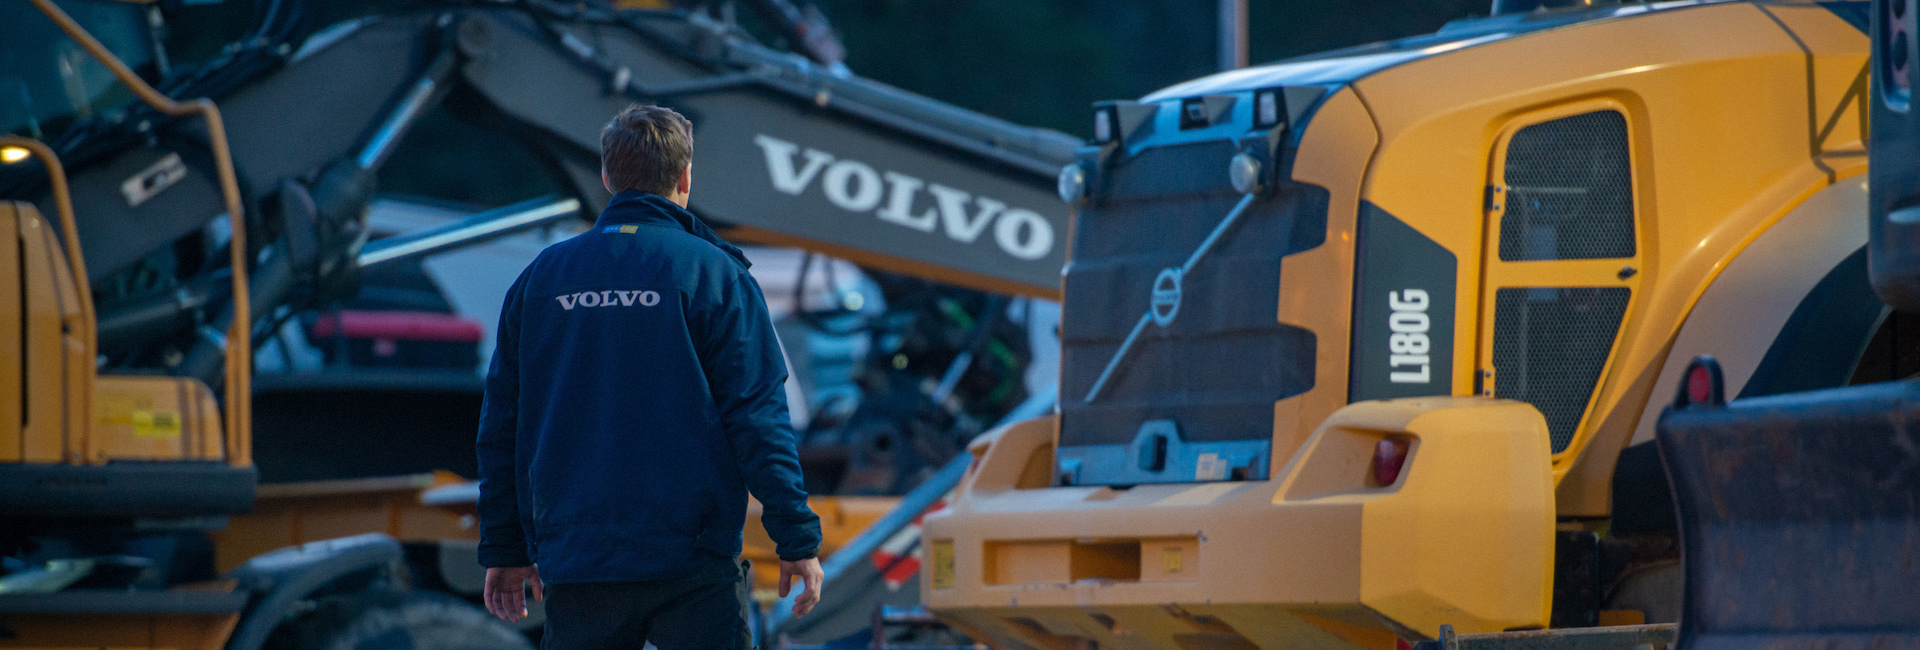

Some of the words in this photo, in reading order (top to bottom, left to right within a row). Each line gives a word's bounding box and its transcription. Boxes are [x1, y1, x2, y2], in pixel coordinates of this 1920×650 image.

[755, 133, 1054, 260] VOLVO
[555, 289, 661, 311] VOLVO
[1389, 288, 1430, 384] L180G
